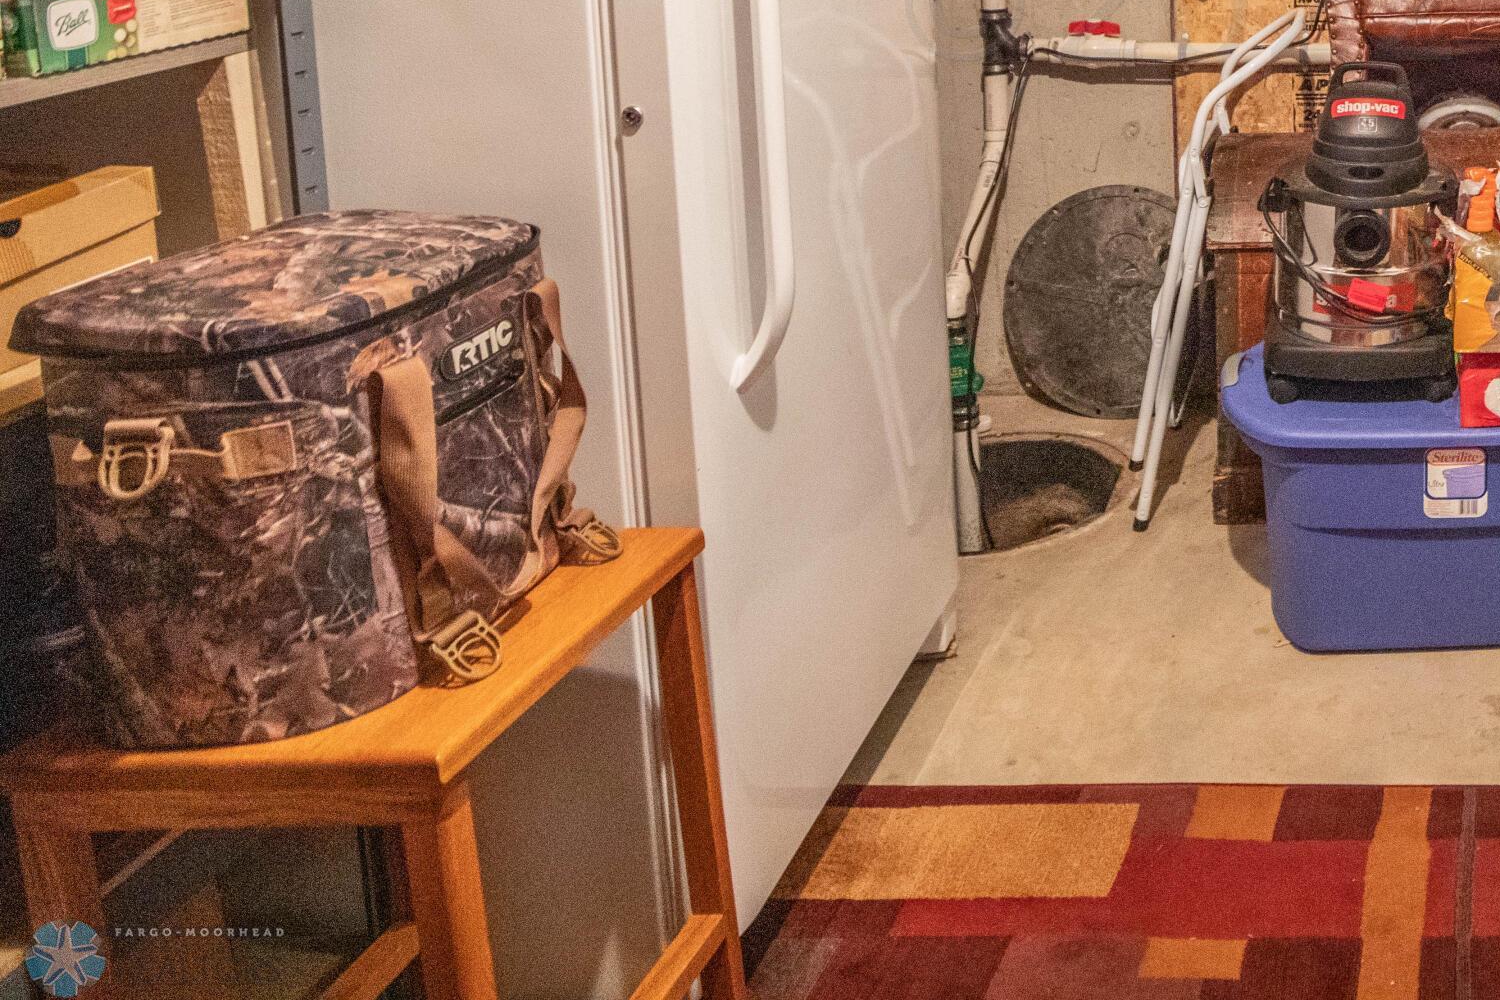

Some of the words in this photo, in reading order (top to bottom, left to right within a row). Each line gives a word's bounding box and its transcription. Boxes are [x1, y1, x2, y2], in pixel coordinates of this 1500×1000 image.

[54, 7, 94, 37] Ball
[451, 319, 514, 375] RTIC
[1431, 451, 1479, 463] Sterilite
